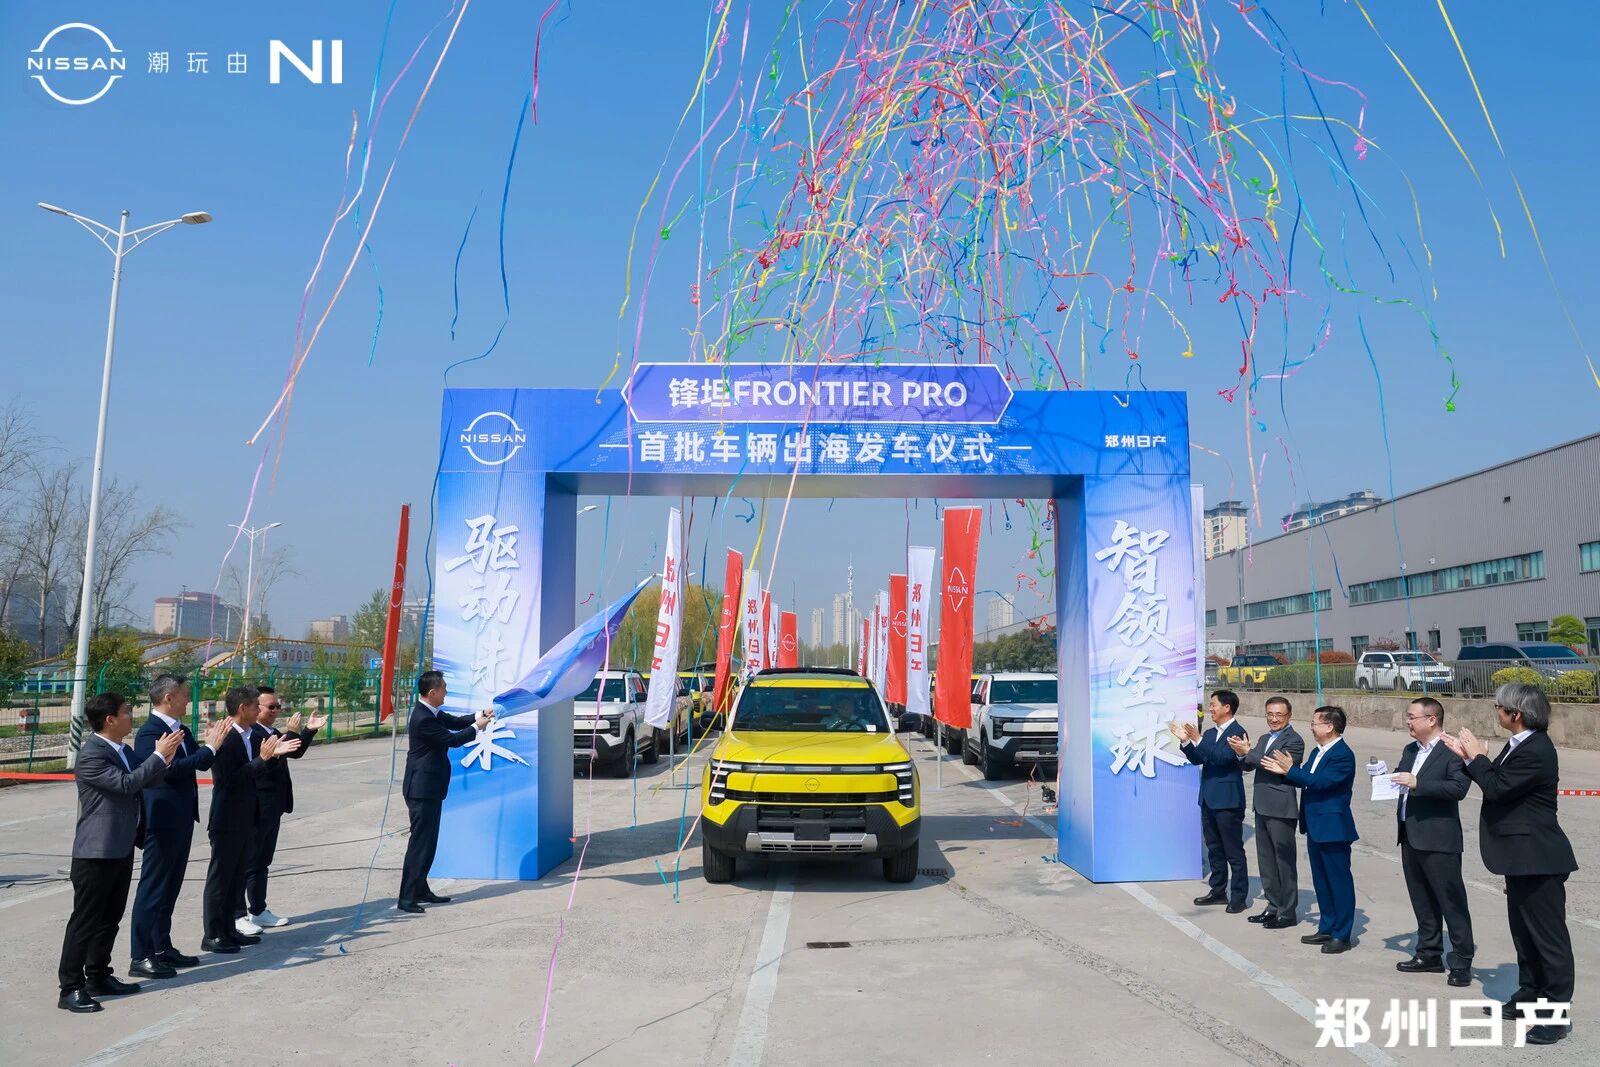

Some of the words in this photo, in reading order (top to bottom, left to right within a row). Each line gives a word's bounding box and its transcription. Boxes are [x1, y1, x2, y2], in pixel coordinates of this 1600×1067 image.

[903, 381, 967, 407] PRO
[460, 434, 526, 443] NISSAN
[638, 431, 993, 464] 首批车辆出海发车仪式
[1104, 434, 1167, 449] 郑州日产
[445, 514, 530, 771] 驱动未来
[1095, 520, 1191, 778] 智领全球
